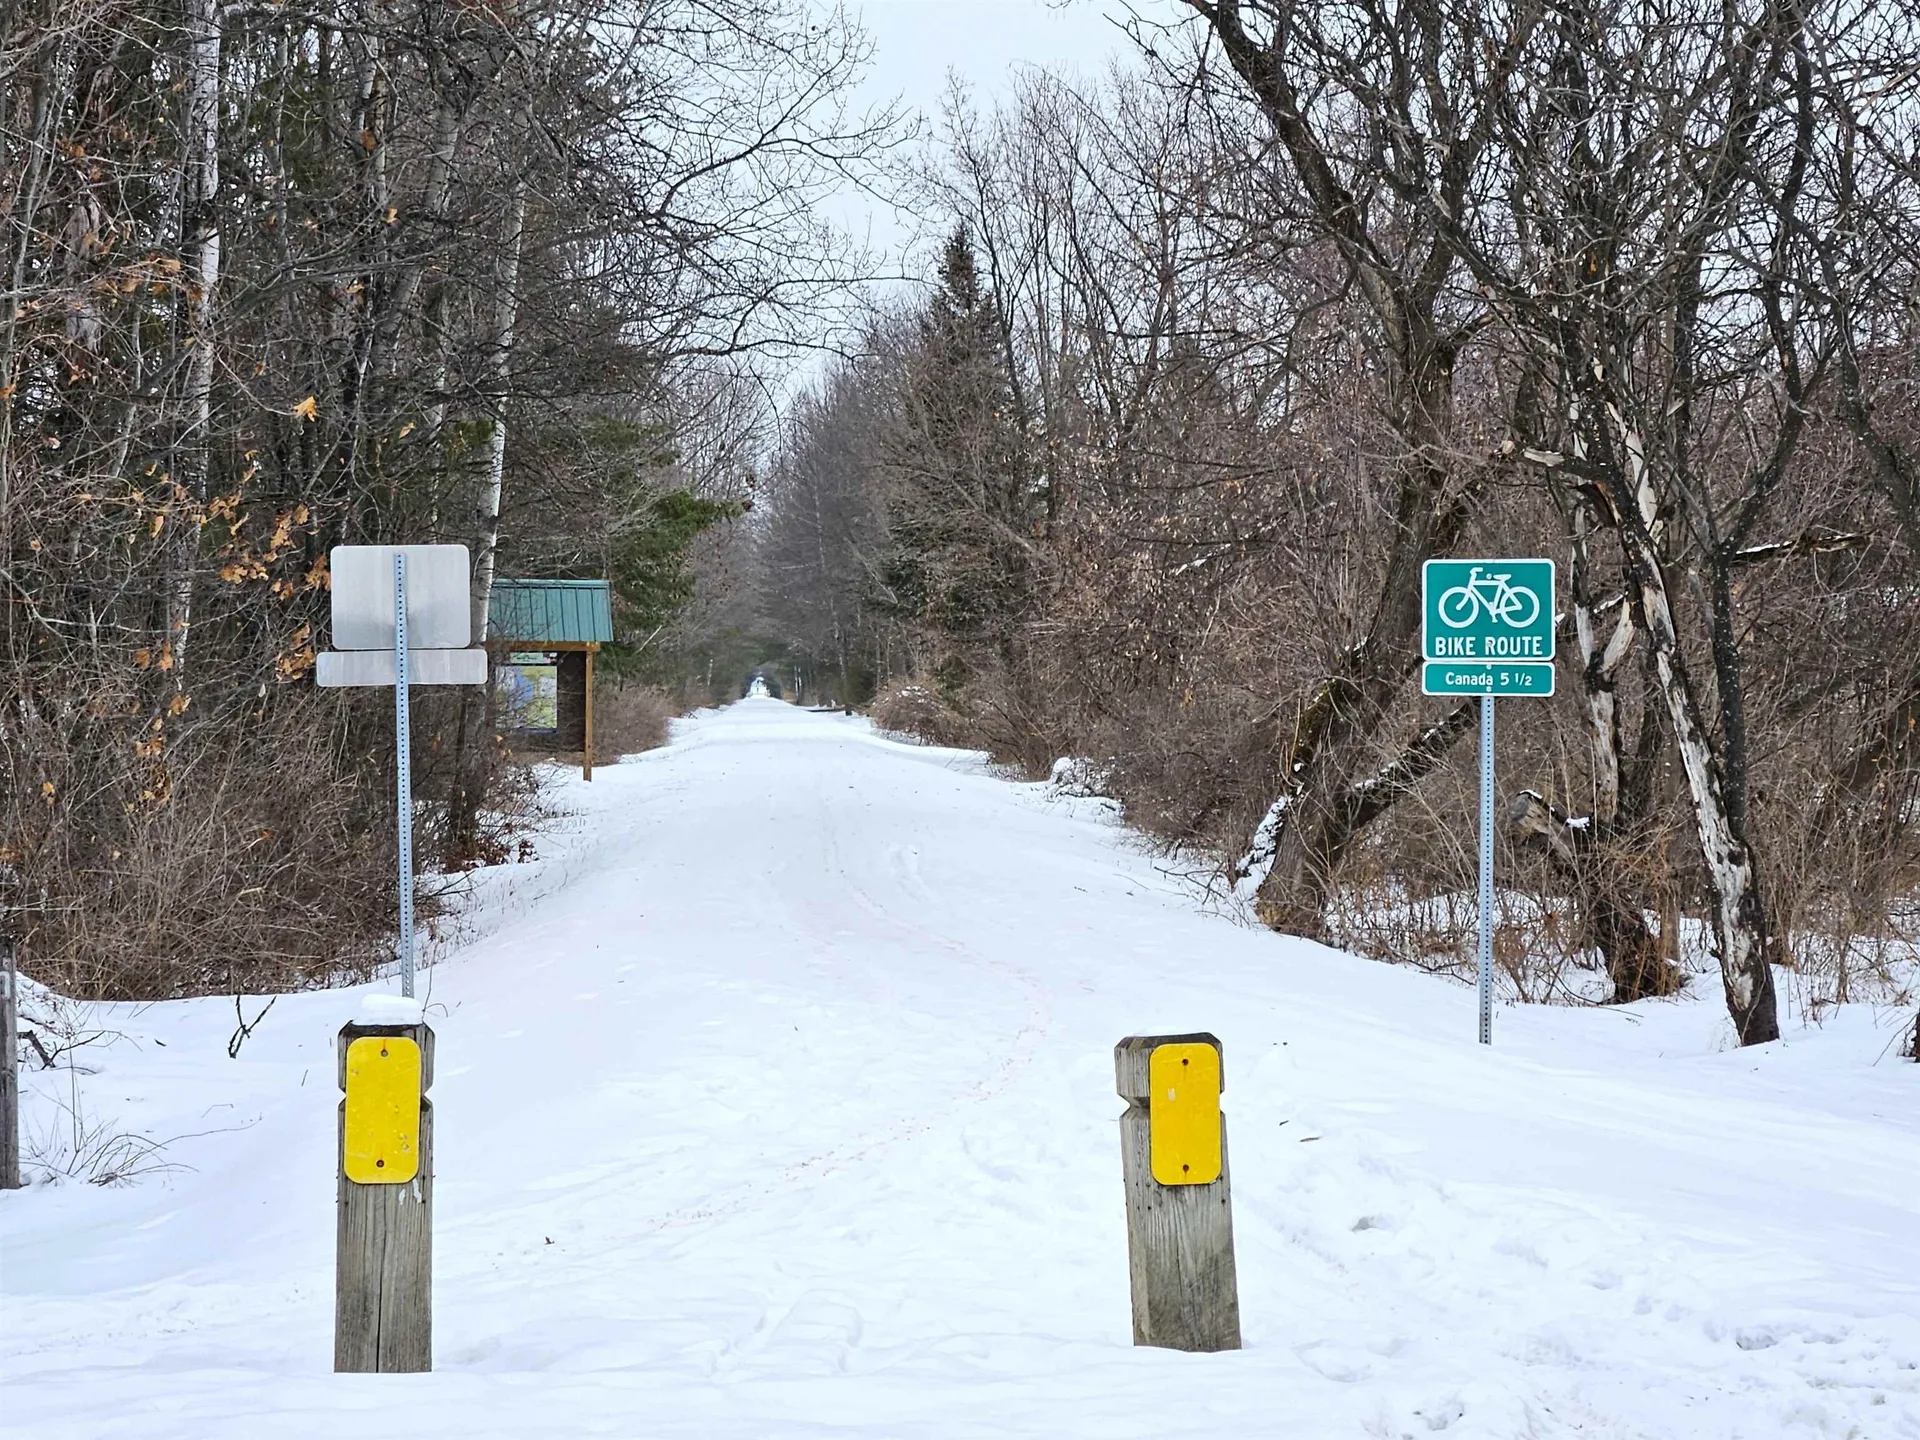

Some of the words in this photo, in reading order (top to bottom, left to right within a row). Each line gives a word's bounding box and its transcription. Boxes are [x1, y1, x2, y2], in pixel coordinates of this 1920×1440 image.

[1435, 636, 1476, 655] BIKE
[1485, 636, 1543, 655] ROUTE
[1445, 671, 1494, 686] Canada
[1500, 672, 1510, 686] 5
